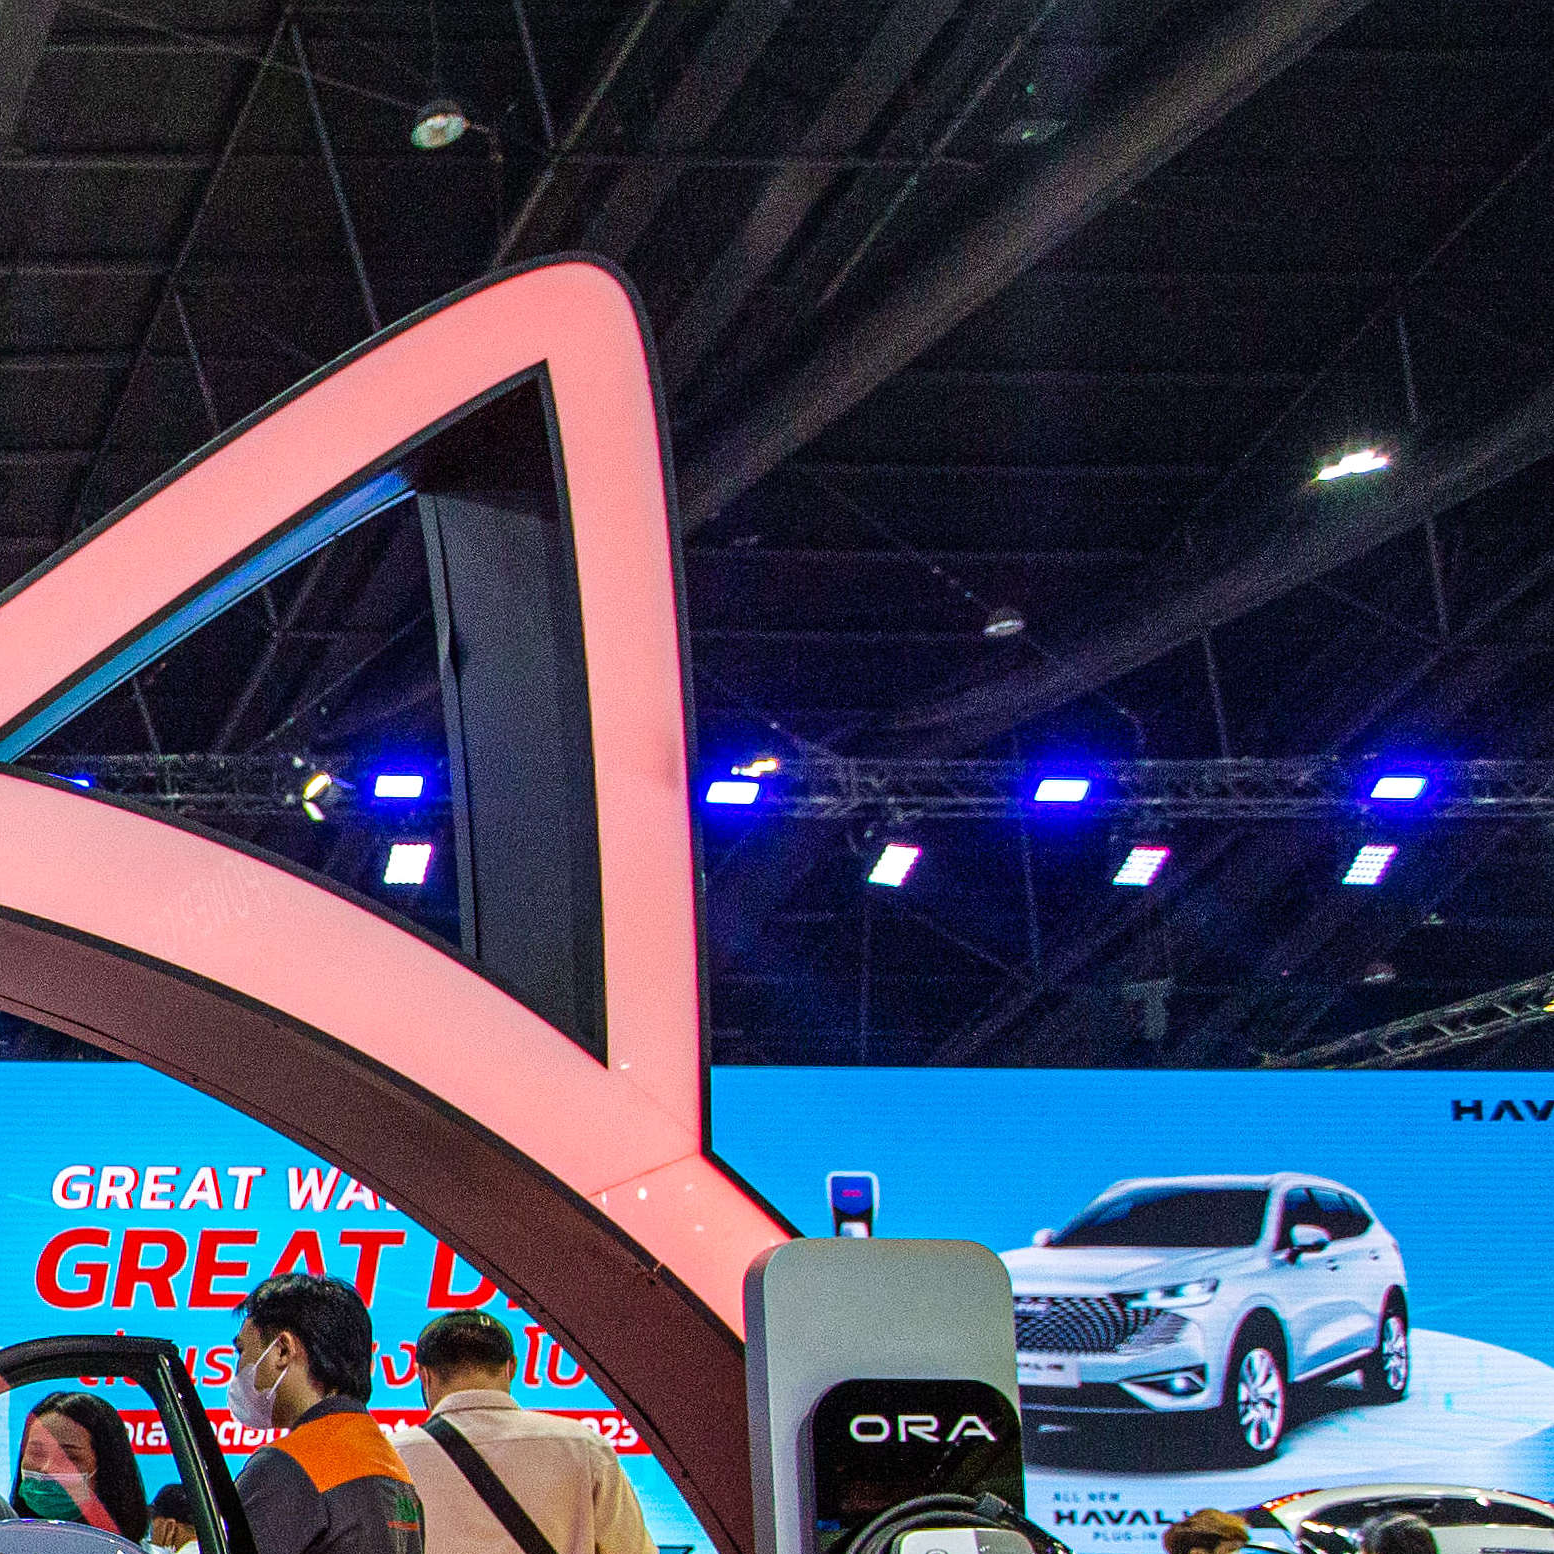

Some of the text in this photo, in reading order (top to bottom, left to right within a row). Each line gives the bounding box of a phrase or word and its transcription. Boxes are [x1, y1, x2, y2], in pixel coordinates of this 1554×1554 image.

[52, 1164, 399, 1211] GREAT WA
[849, 1414, 997, 1443] ORA
[1054, 1508, 1174, 1526] HAVAL
